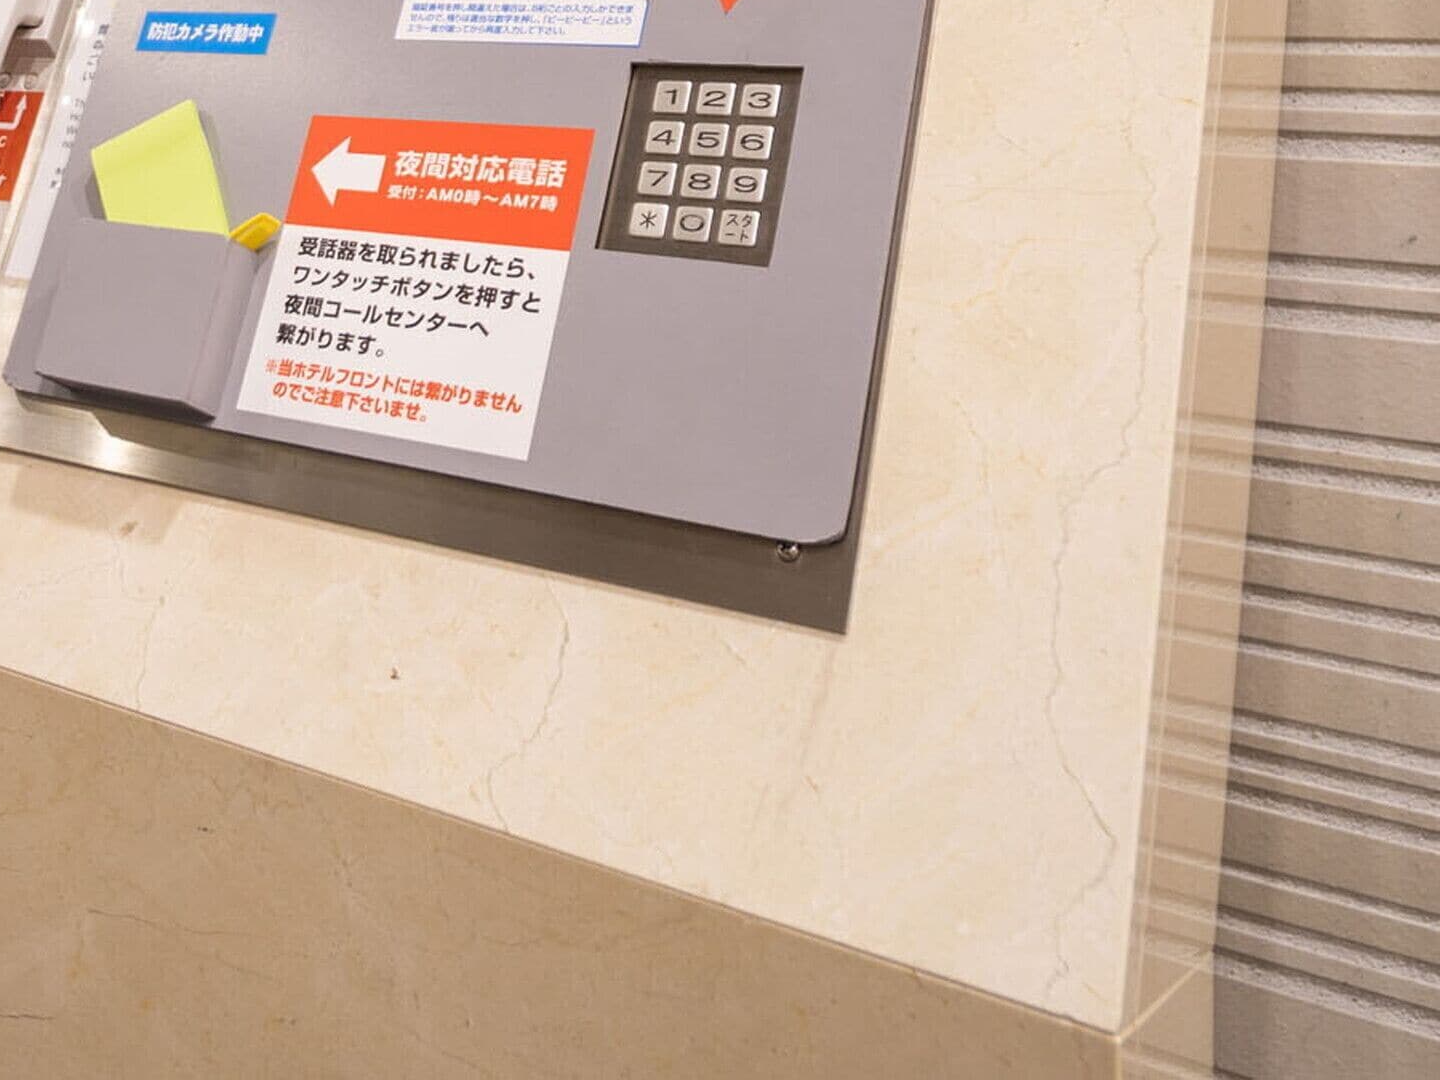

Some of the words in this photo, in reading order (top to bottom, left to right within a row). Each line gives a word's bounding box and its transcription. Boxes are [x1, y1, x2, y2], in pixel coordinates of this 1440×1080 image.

[146, 21, 265, 43] 防犯カメラ作動中
[665, 88, 678, 106] 1
[702, 90, 727, 108] 2
[747, 91, 772, 110] 3
[652, 129, 675, 146] 4
[696, 131, 721, 149] 5
[740, 133, 765, 151] 6
[394, 150, 568, 188] 夜間対応電話
[647, 169, 669, 188] 7
[687, 172, 712, 191] 8
[733, 175, 758, 193] 9
[679, 214, 705, 232] 0
[297, 236, 539, 281] 受話器を取られましたら、
[292, 265, 542, 315] ワンタッチボタンを押すと
[283, 294, 490, 337] 夜間コールセンターへ
[275, 322, 385, 358] 繋がります。
[265, 359, 523, 414] ※当ホテルフロントには繋がりません
[272, 381, 427, 423] のでご注意下さいませ。
